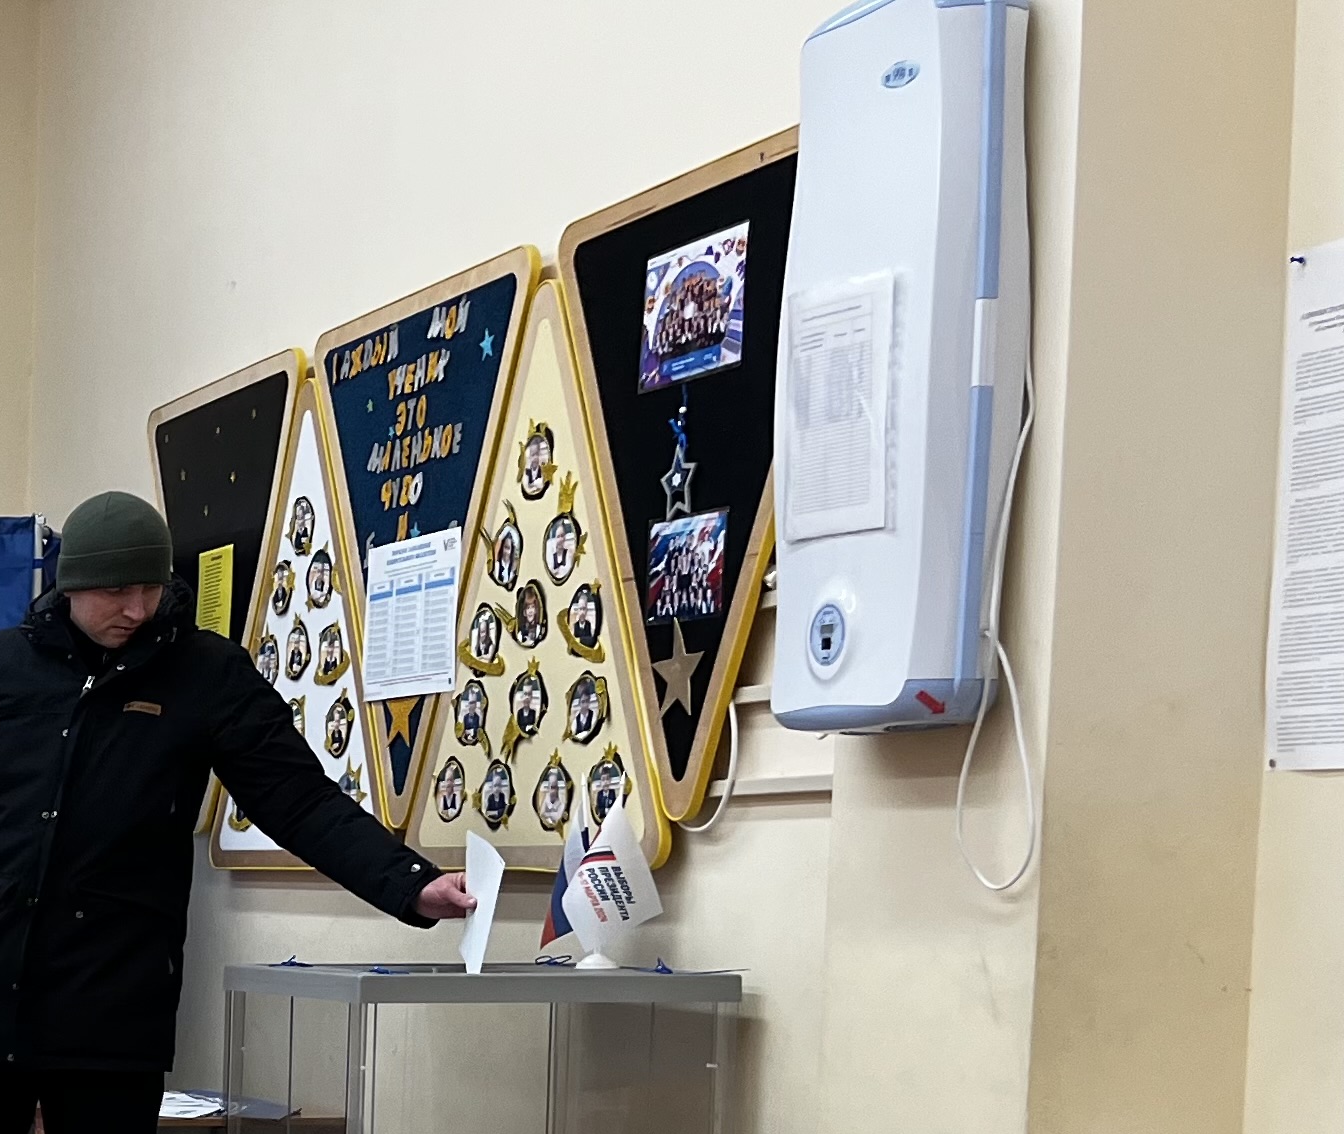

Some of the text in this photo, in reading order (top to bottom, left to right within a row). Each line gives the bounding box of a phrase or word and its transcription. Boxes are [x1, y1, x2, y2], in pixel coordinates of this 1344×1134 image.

[396, 395, 427, 436] ЭТО
[585, 868, 610, 901] РОССИИ
[598, 866, 630, 921] ПРЕЗИДЕНТА
[611, 866, 636, 905] ВЫБОРЫ
